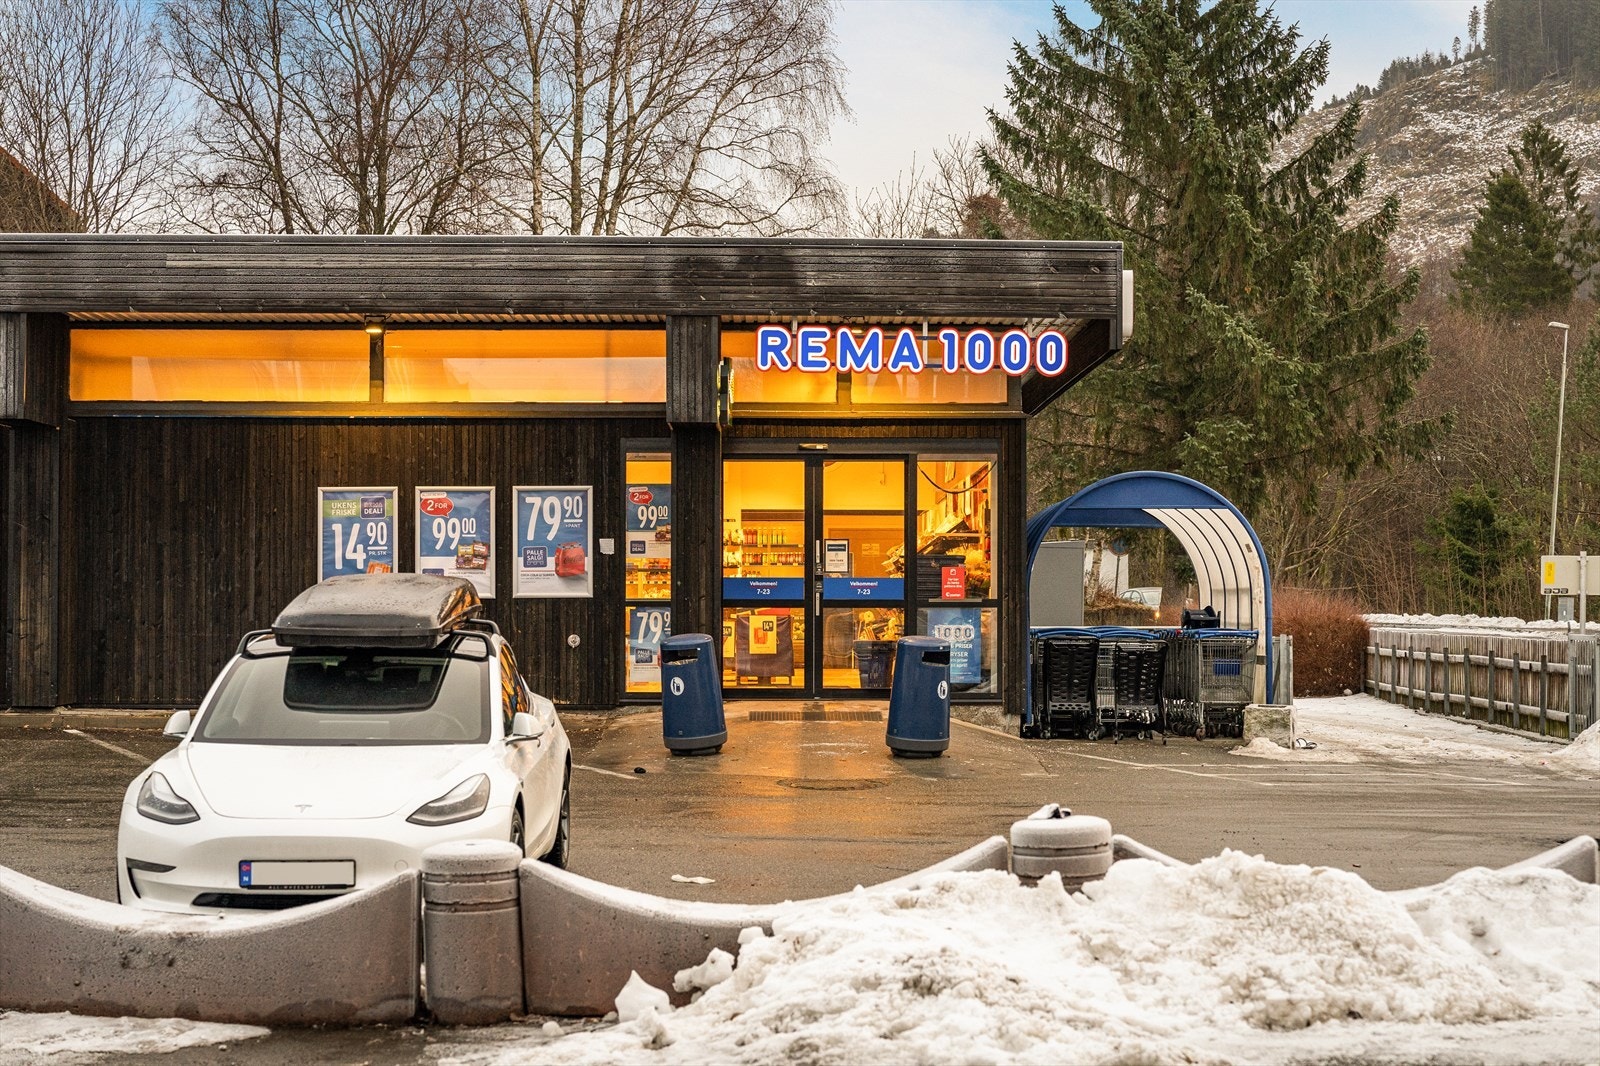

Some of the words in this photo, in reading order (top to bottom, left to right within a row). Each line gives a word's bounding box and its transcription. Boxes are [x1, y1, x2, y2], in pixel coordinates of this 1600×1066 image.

[756, 326, 924, 373] REMA
[937, 327, 1068, 376] 1000
[363, 507, 383, 515] DEAL!
[426, 499, 434, 511] 2
[663, 611, 671, 627] 9
